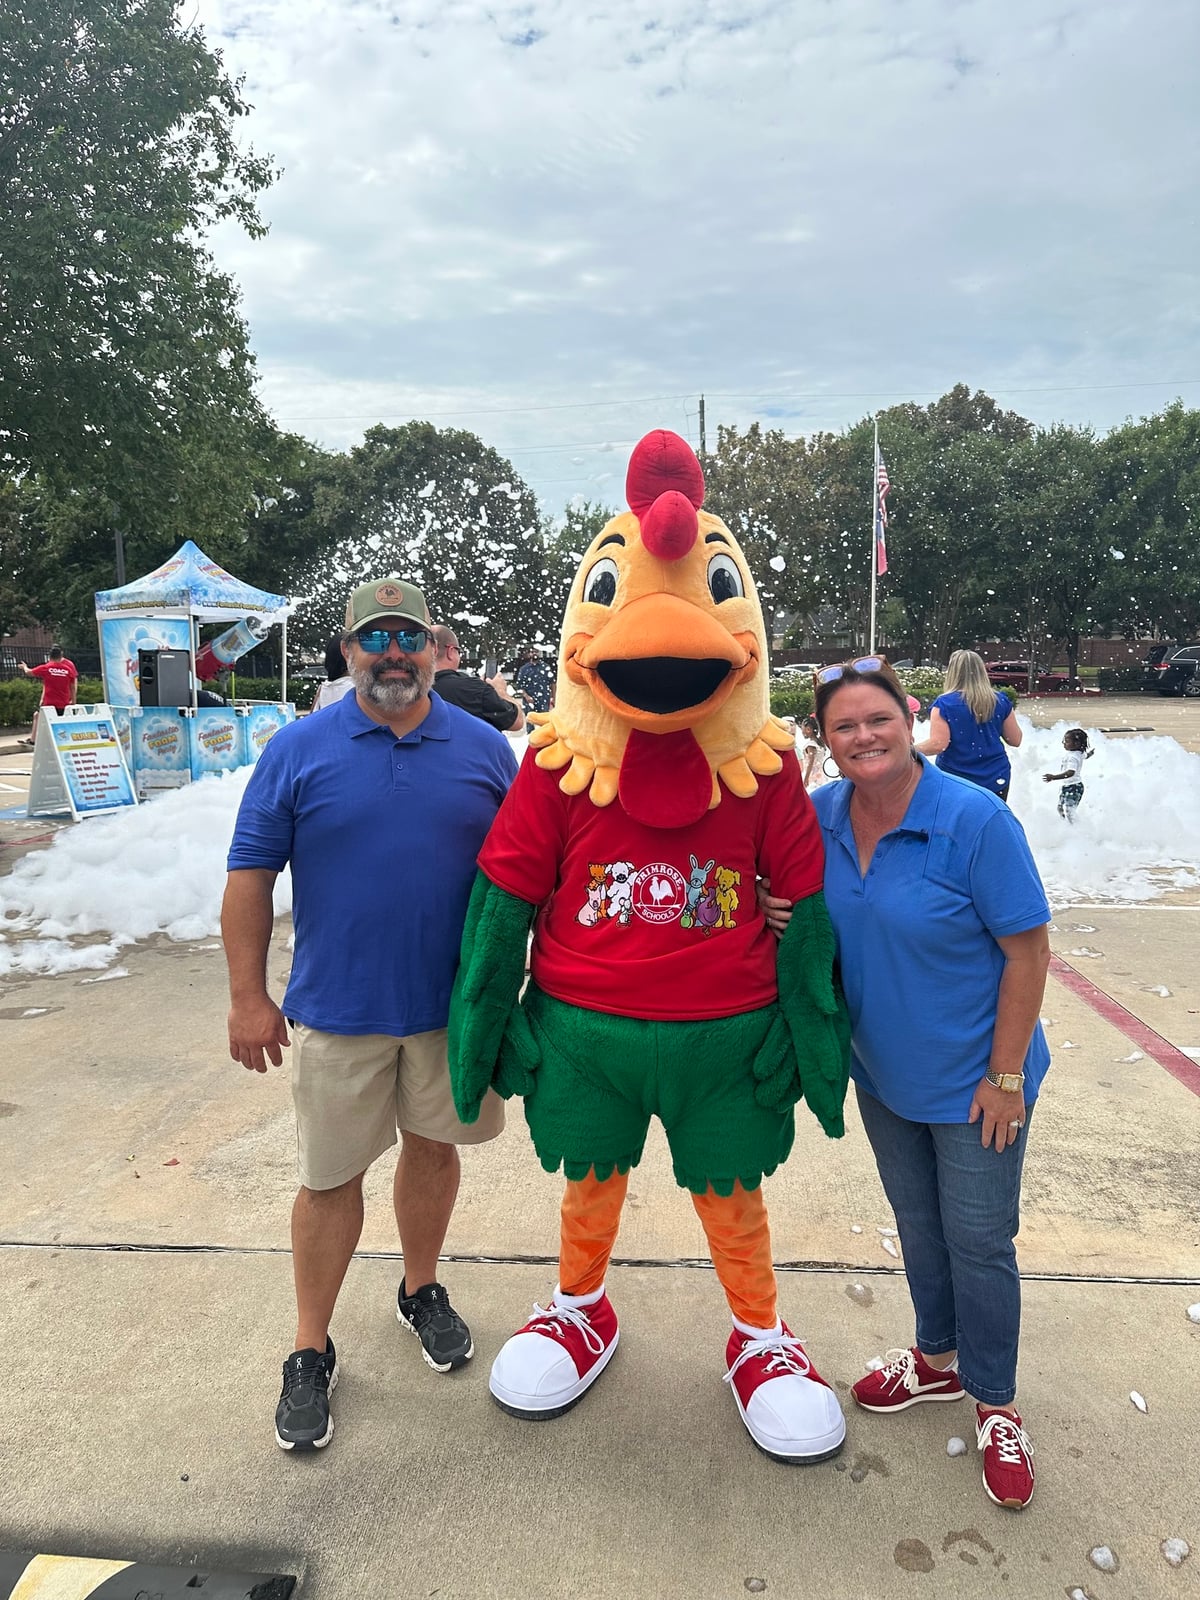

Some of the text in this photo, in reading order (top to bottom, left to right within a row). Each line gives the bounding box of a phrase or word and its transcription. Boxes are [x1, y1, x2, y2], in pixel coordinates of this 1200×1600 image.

[198, 725, 234, 741] Fantastic
[203, 732, 233, 748] FOAM
[148, 734, 178, 750] FOAM
[636, 865, 683, 887] PRIMROSE
[642, 909, 675, 920] SCHOOLS
